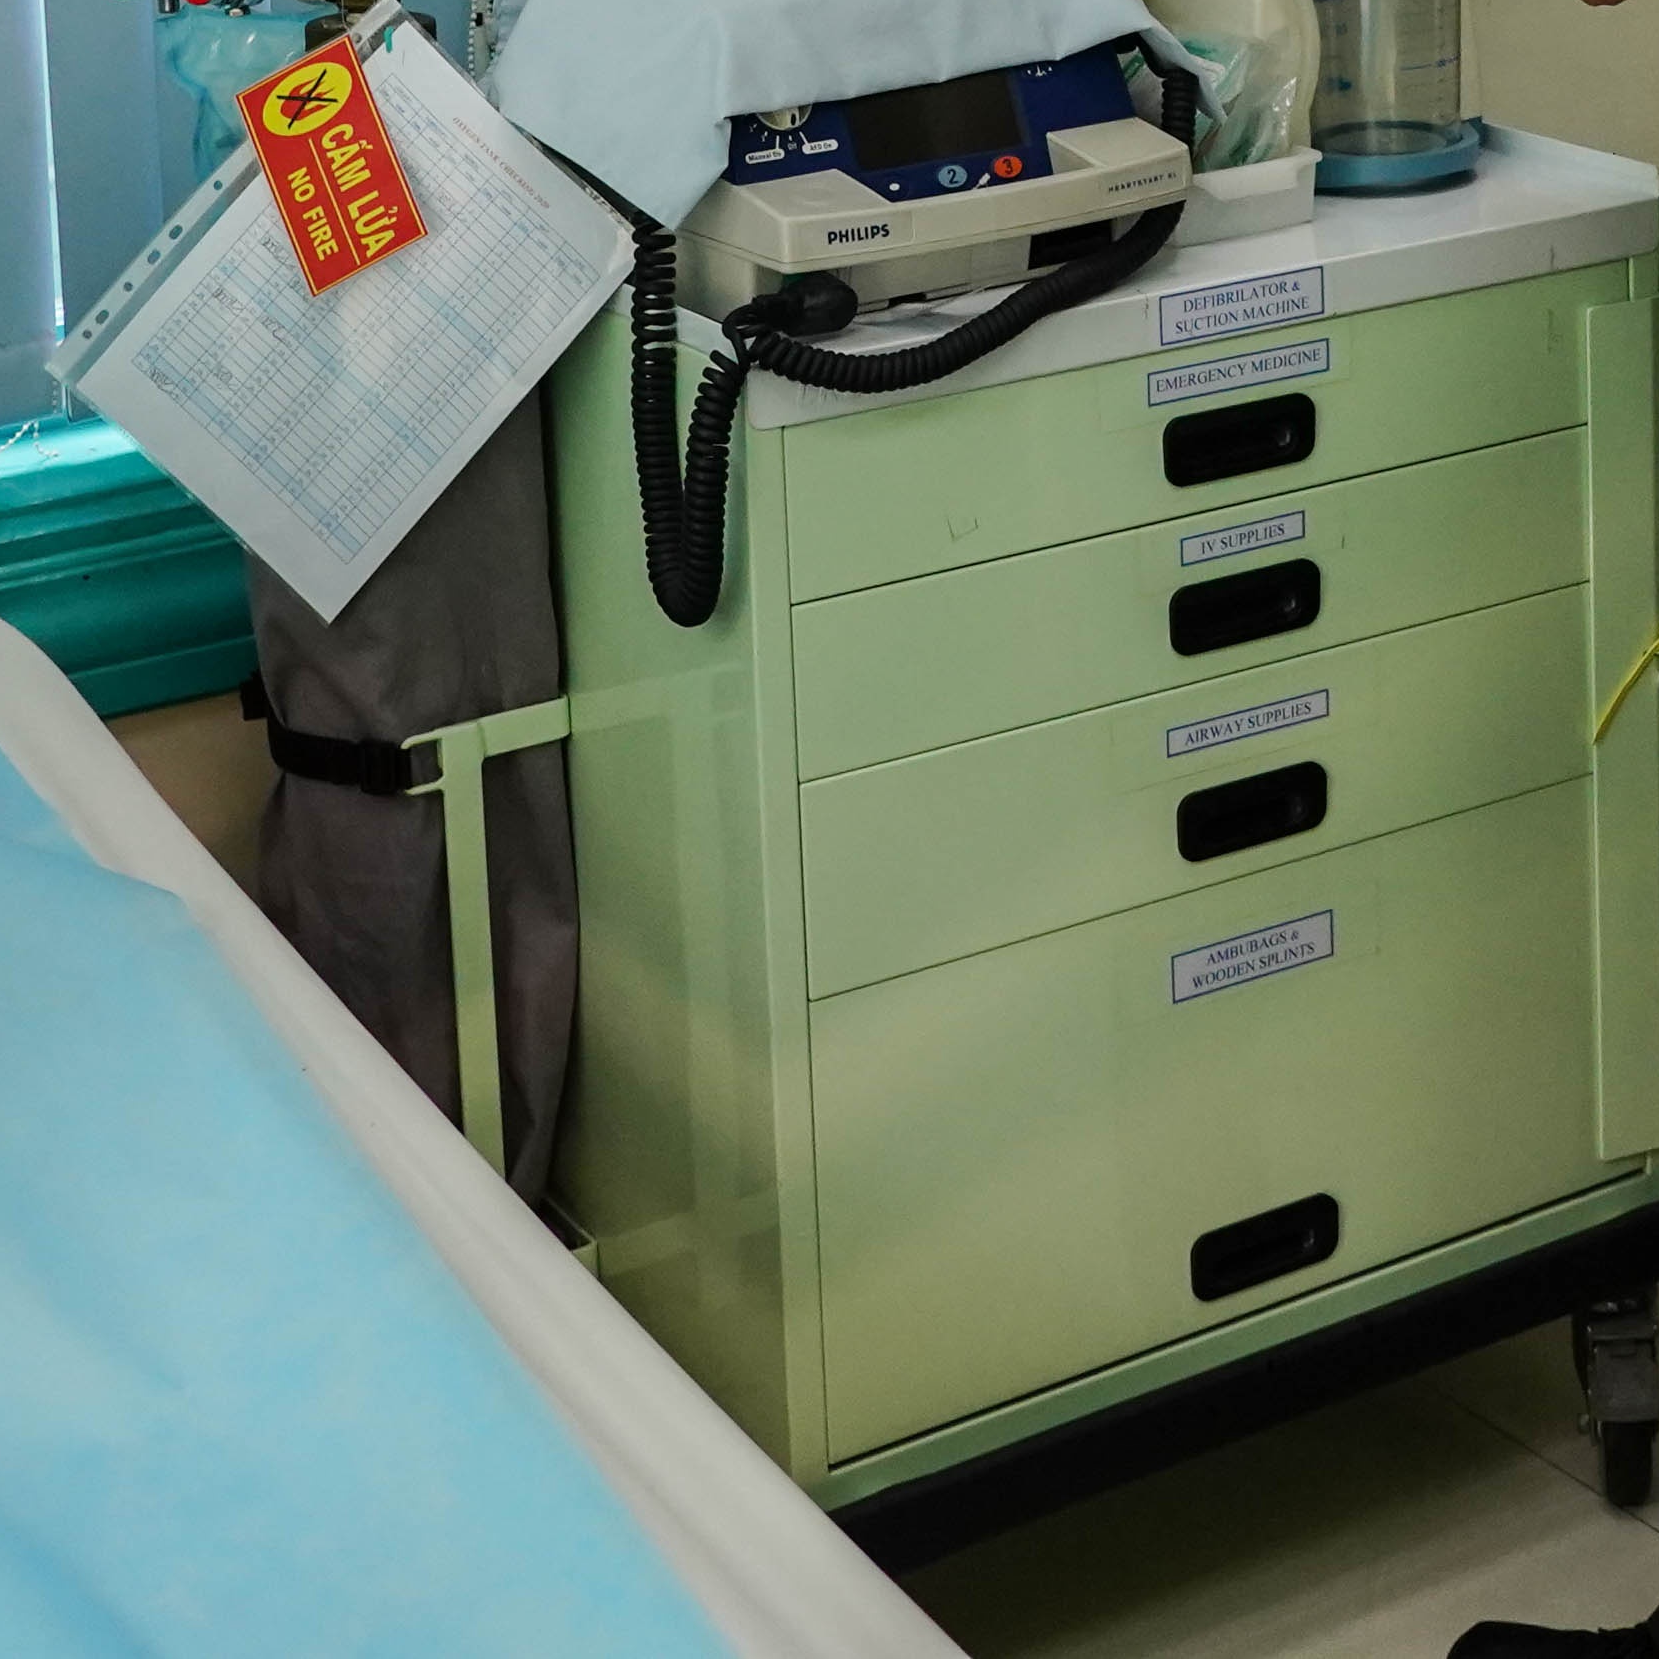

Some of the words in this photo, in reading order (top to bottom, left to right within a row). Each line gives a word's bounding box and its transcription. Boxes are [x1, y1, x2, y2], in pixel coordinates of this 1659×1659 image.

[946, 168, 959, 185] 2
[1002, 158, 1013, 175] 3
[320, 122, 374, 193] CẤM
[347, 190, 399, 259] LỬA
[286, 166, 317, 204] NO
[302, 205, 340, 262] FIRE
[827, 223, 890, 245] PHILIPS
[1175, 310, 1241, 335] SUCTION
[1242, 295, 1310, 320] MACHINE
[1183, 280, 1288, 313] DEFIBRILATOR
[1291, 280, 1301, 292] &
[1156, 361, 1249, 393] EMERGENCY
[1251, 347, 1322, 373] MEDICINE
[1200, 540, 1217, 555] IV
[1220, 522, 1286, 550] SUPPLIES
[1184, 720, 1244, 746] AIRWAY
[1247, 701, 1312, 729] SUPPLIES
[1192, 960, 1255, 990] WOODEN
[1258, 941, 1316, 970] SPLINTS
[1207, 929, 1288, 966] AMBUBAGS
